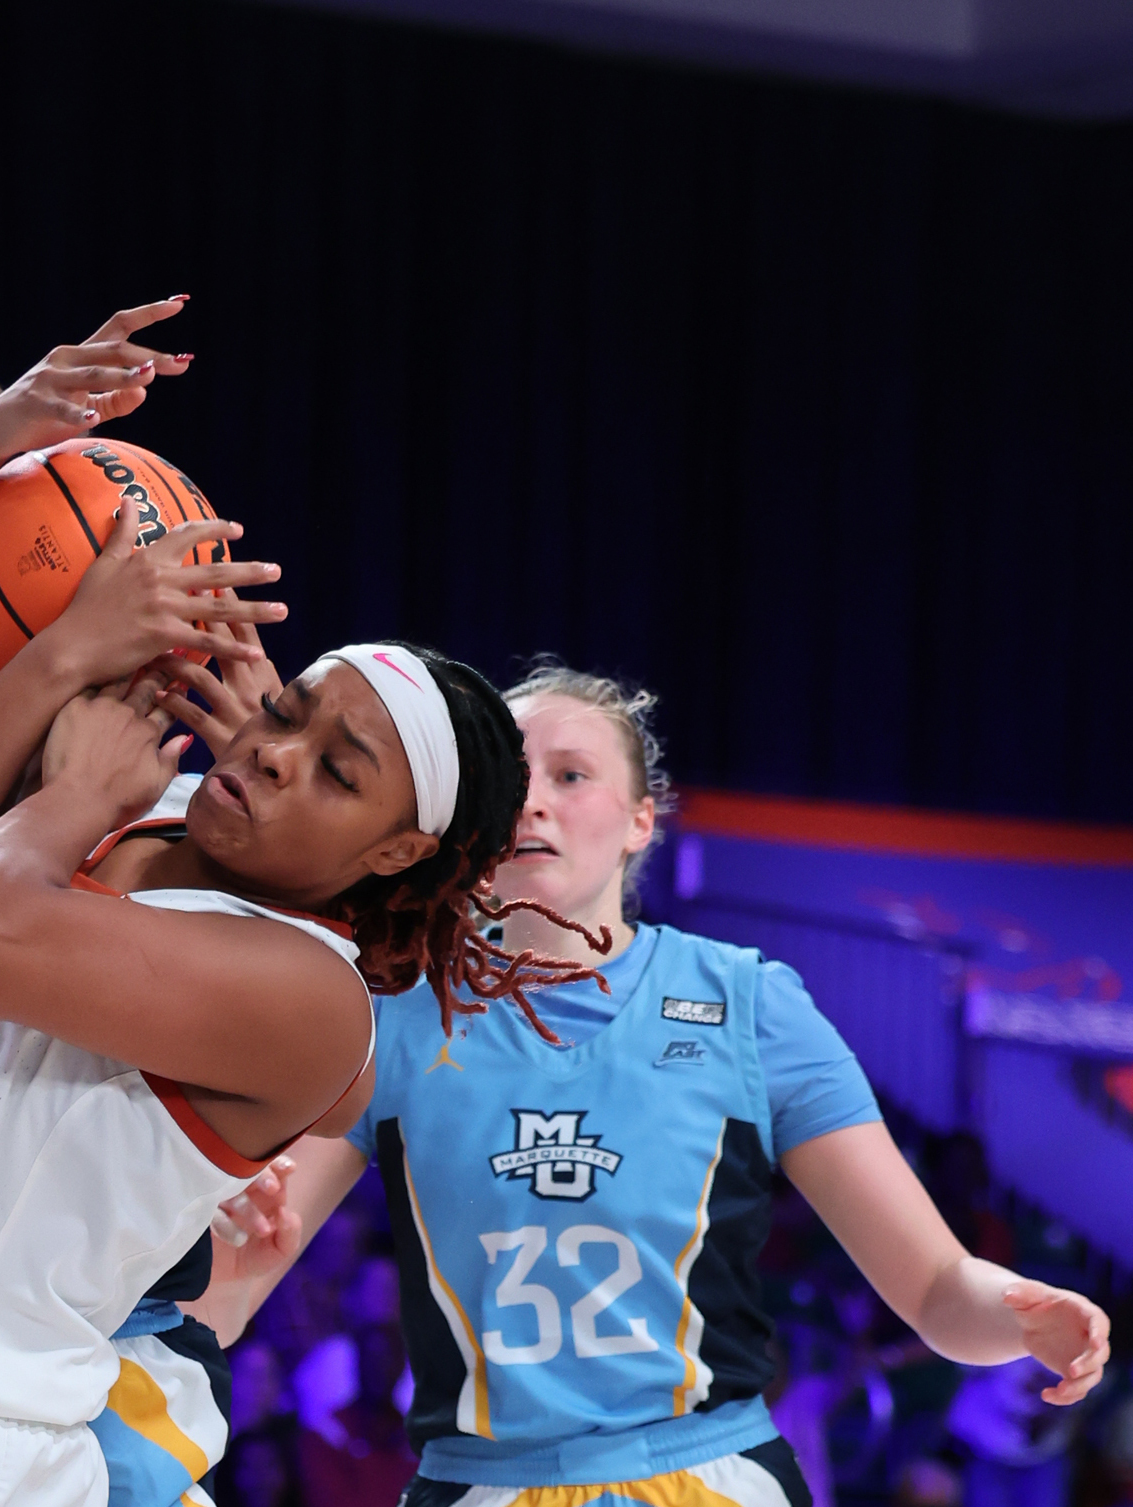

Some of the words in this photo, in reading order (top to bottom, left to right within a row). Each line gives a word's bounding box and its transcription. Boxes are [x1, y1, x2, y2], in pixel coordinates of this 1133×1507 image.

[81, 443, 169, 550] ilson
[38, 524, 69, 573] ATLANTIS
[499, 1148, 613, 1169] MARQUETTE
[478, 1224, 660, 1366] 32
